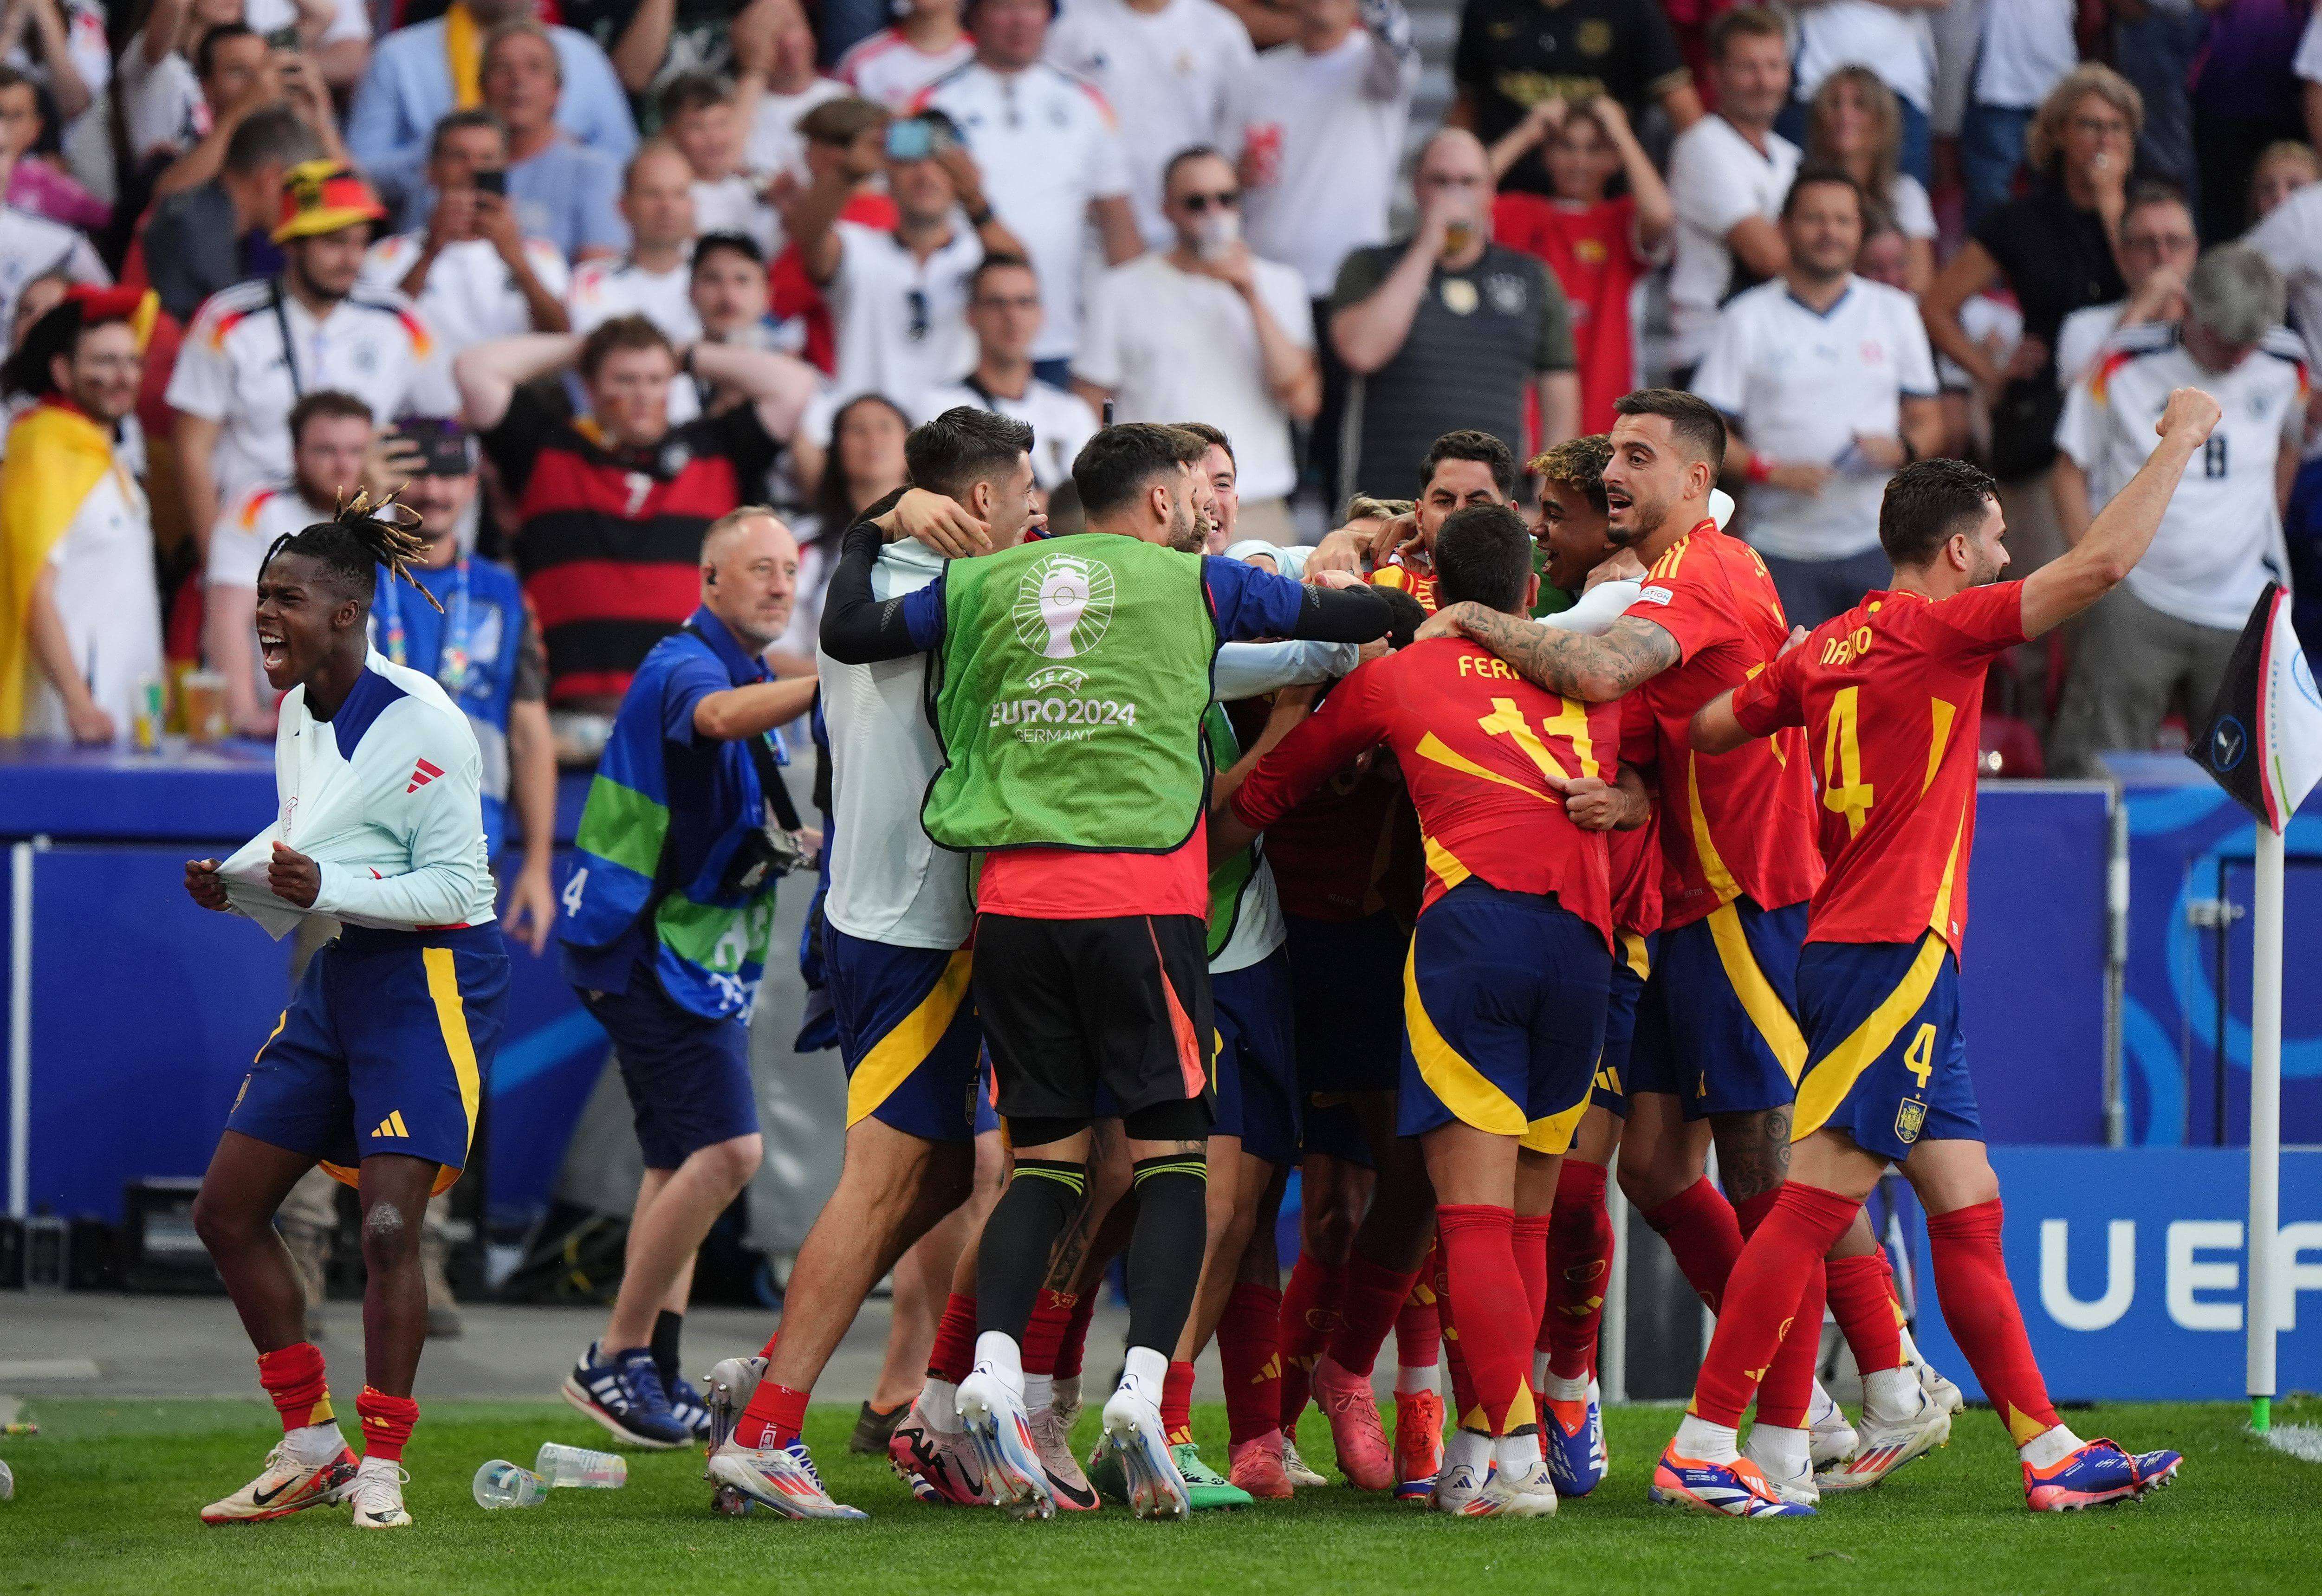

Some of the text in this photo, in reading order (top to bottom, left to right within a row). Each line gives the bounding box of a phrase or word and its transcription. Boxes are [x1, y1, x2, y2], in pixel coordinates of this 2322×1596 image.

[624, 472, 653, 516] 7
[1028, 671, 1082, 690] UEFA
[990, 698, 1136, 727] EURO2024
[1015, 729, 1096, 743] GERMANY
[1478, 698, 1599, 779] 11
[1824, 685, 1874, 840] 4
[1904, 1023, 1937, 1088] 4
